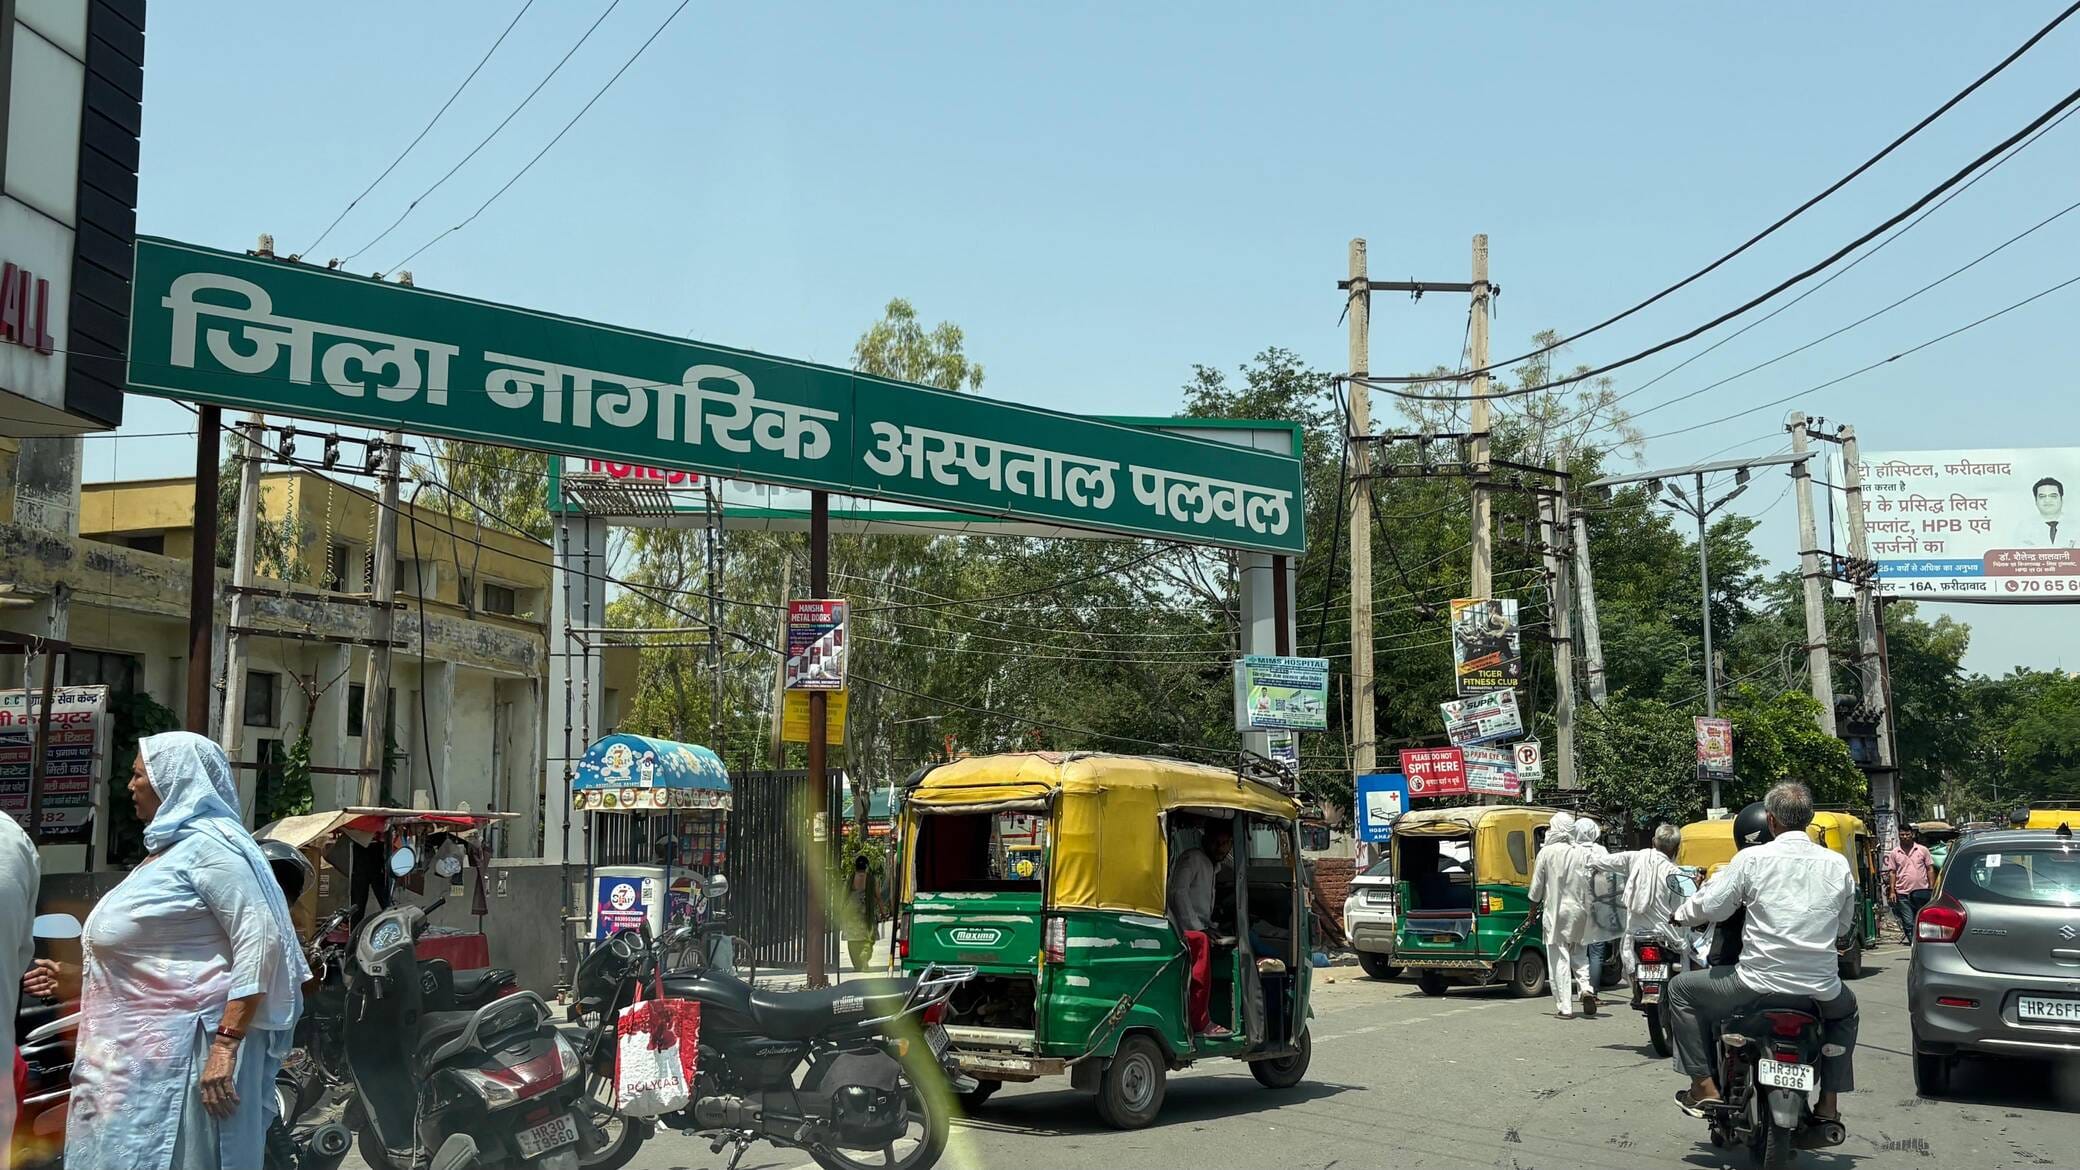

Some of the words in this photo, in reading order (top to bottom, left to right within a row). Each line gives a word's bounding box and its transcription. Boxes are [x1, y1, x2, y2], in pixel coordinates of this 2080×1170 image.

[162, 272, 459, 406] जिला
[484, 351, 838, 460] नागरिक
[863, 421, 1120, 509] अस्पताल
[1128, 464, 1293, 536] पलवल
[1874, 460, 1939, 479] हॉस्पिटल,
[1874, 483, 1897, 492] करता
[1899, 480, 1906, 492] है
[1876, 495, 1893, 512] के
[1898, 494, 1945, 514] प्रसिद्ध
[1950, 493, 1988, 512] लिवर
[1922, 519, 1962, 532] HPB
[1968, 515, 1991, 534] एवं
[1872, 535, 1918, 554] सर्जनों
[1922, 540, 1944, 553] का
[1910, 581, 1937, 593] 16A,
[2021, 580, 2040, 592] 70
[2044, 580, 2065, 591] 65
[2068, 580, 2080, 591] 6
[799, 604, 824, 613] MANSHA
[791, 613, 810, 622] METAL
[811, 613, 831, 622] DOORS
[1257, 657, 1282, 665] MIMS
[1284, 658, 1325, 668] HOSPITAL
[1463, 678, 1496, 686] FITNESS
[1497, 678, 1518, 686] CLUB
[57, 692, 75, 705] सेवा
[1441, 752, 1452, 760] NOT
[1408, 762, 1430, 774] SPIT
[1433, 761, 1460, 772] HERE
[957, 931, 995, 941] Maxima
[1774, 1075, 1804, 1089] 6036
[531, 1119, 565, 1140] HR30
